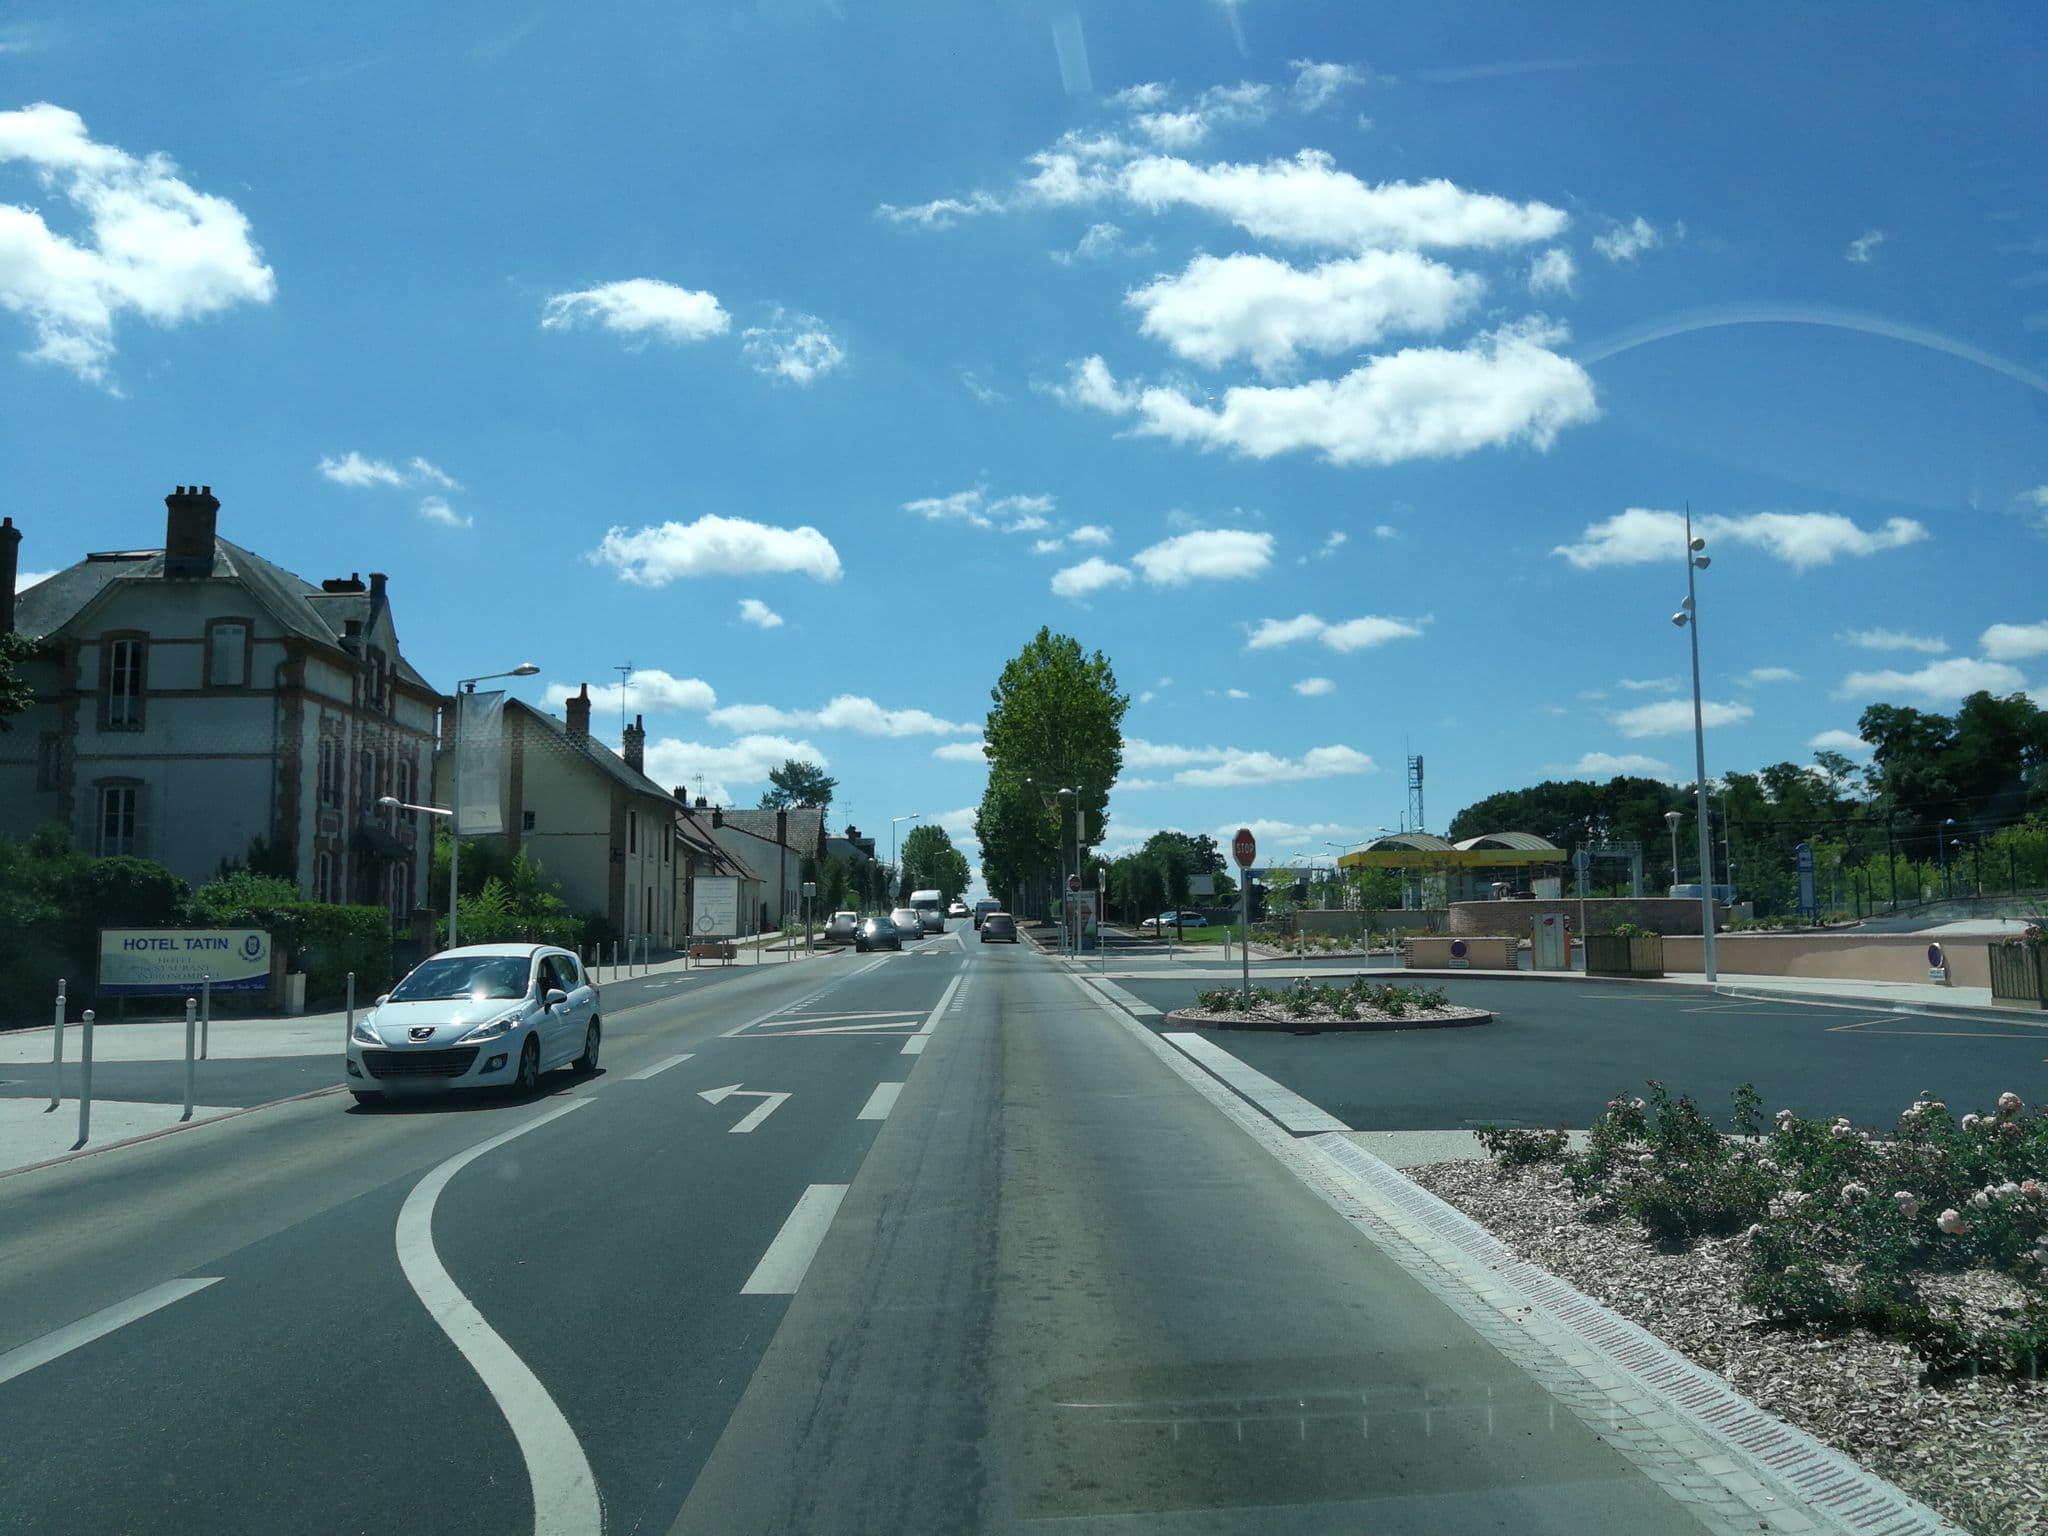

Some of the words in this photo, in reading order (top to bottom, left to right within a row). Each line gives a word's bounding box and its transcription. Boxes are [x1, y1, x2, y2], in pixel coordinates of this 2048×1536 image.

[1236, 843, 1254, 853] STOP
[123, 938, 179, 951] HOTEL
[184, 938, 229, 950] TATIN
